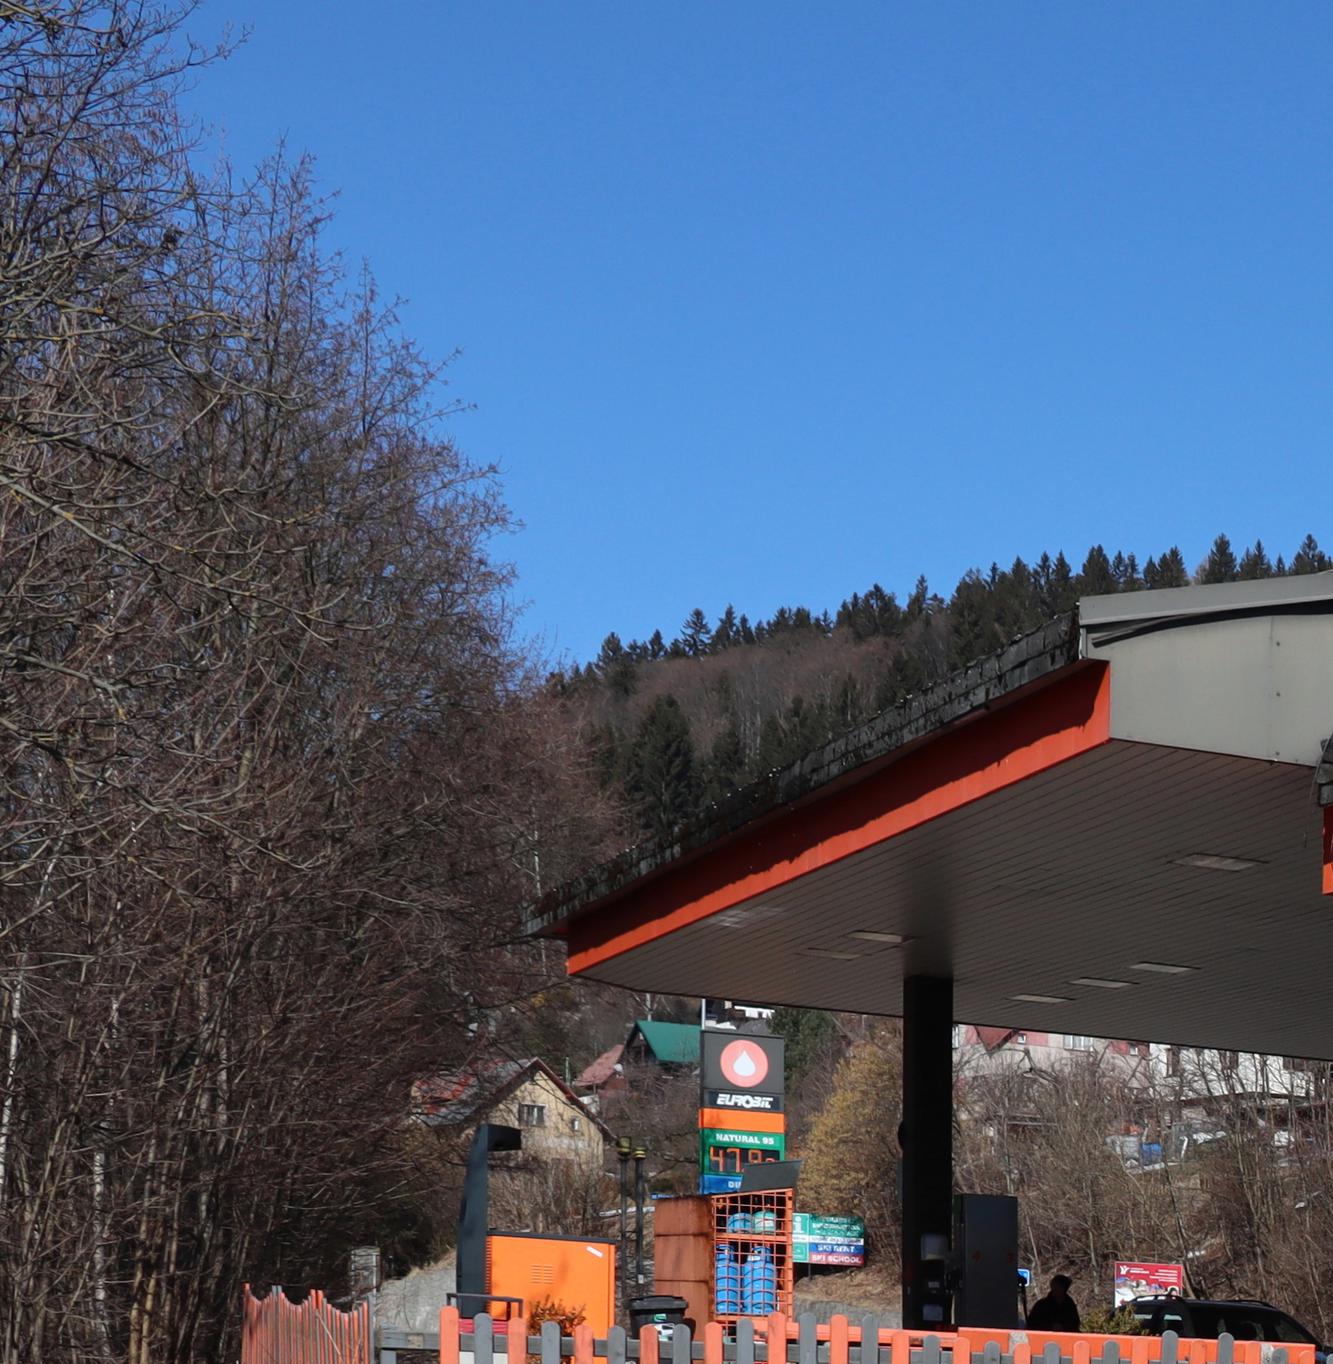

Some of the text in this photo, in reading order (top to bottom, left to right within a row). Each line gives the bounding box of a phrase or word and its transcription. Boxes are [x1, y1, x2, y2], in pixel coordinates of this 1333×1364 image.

[715, 1132, 775, 1145] NATURAL 95
[827, 1255, 862, 1264] SCHOOL
